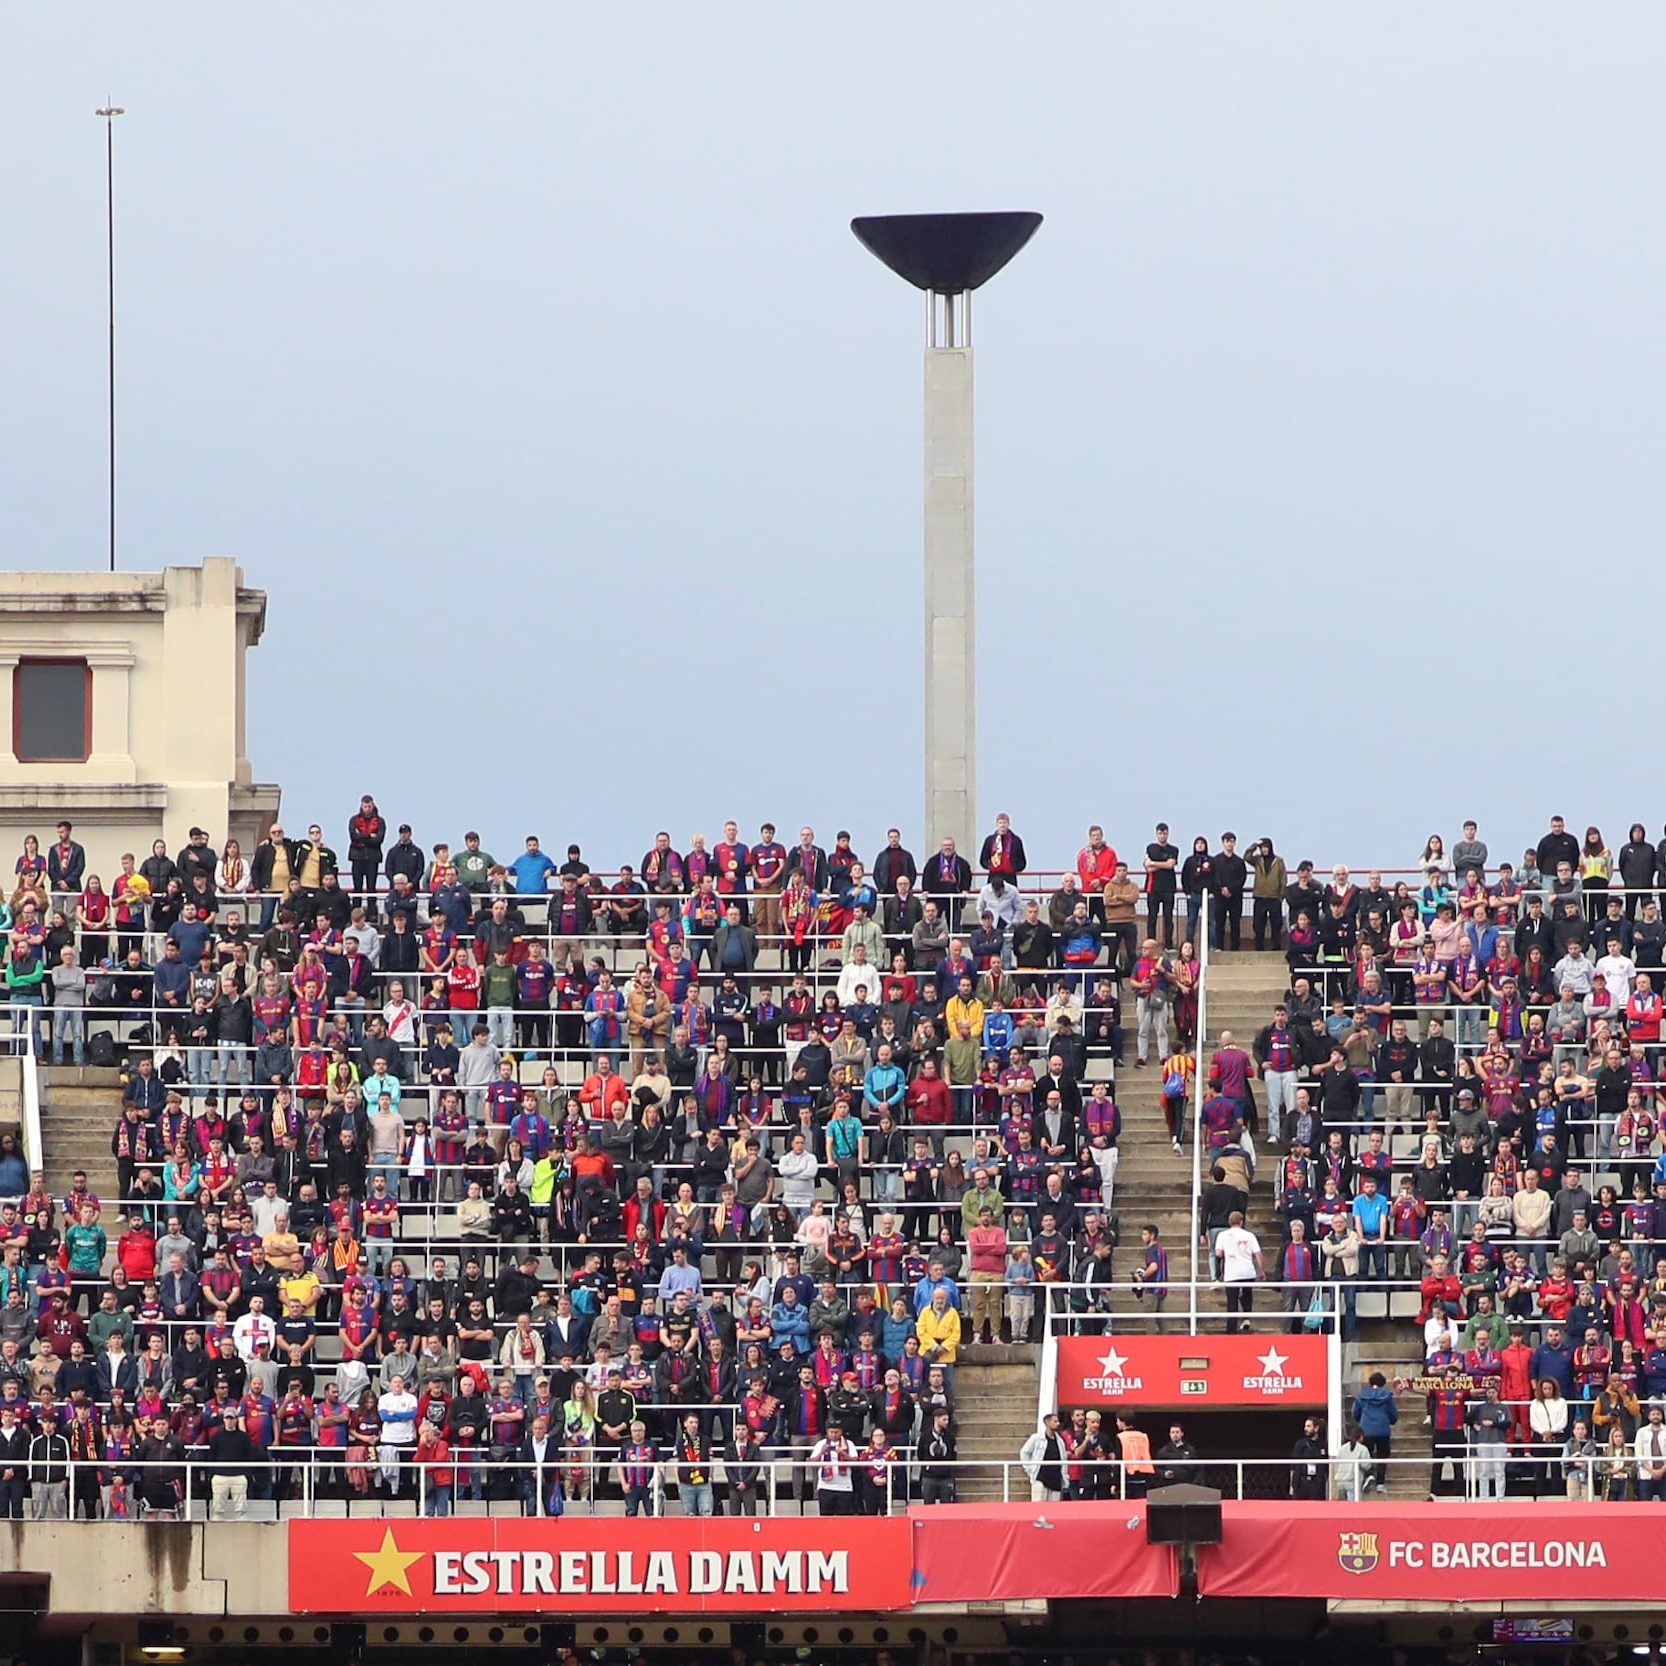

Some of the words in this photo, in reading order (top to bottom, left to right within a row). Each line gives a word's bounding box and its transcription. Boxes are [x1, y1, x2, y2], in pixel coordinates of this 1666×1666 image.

[1084, 1377, 1143, 1389] ESTRELLA
[1243, 1376, 1302, 1388] ESTRELLA
[1390, 1541, 1423, 1568] FC
[1431, 1541, 1607, 1568] BARCELONA
[434, 1551, 678, 1594] ESTRELLA
[689, 1551, 849, 1593] DAMM
